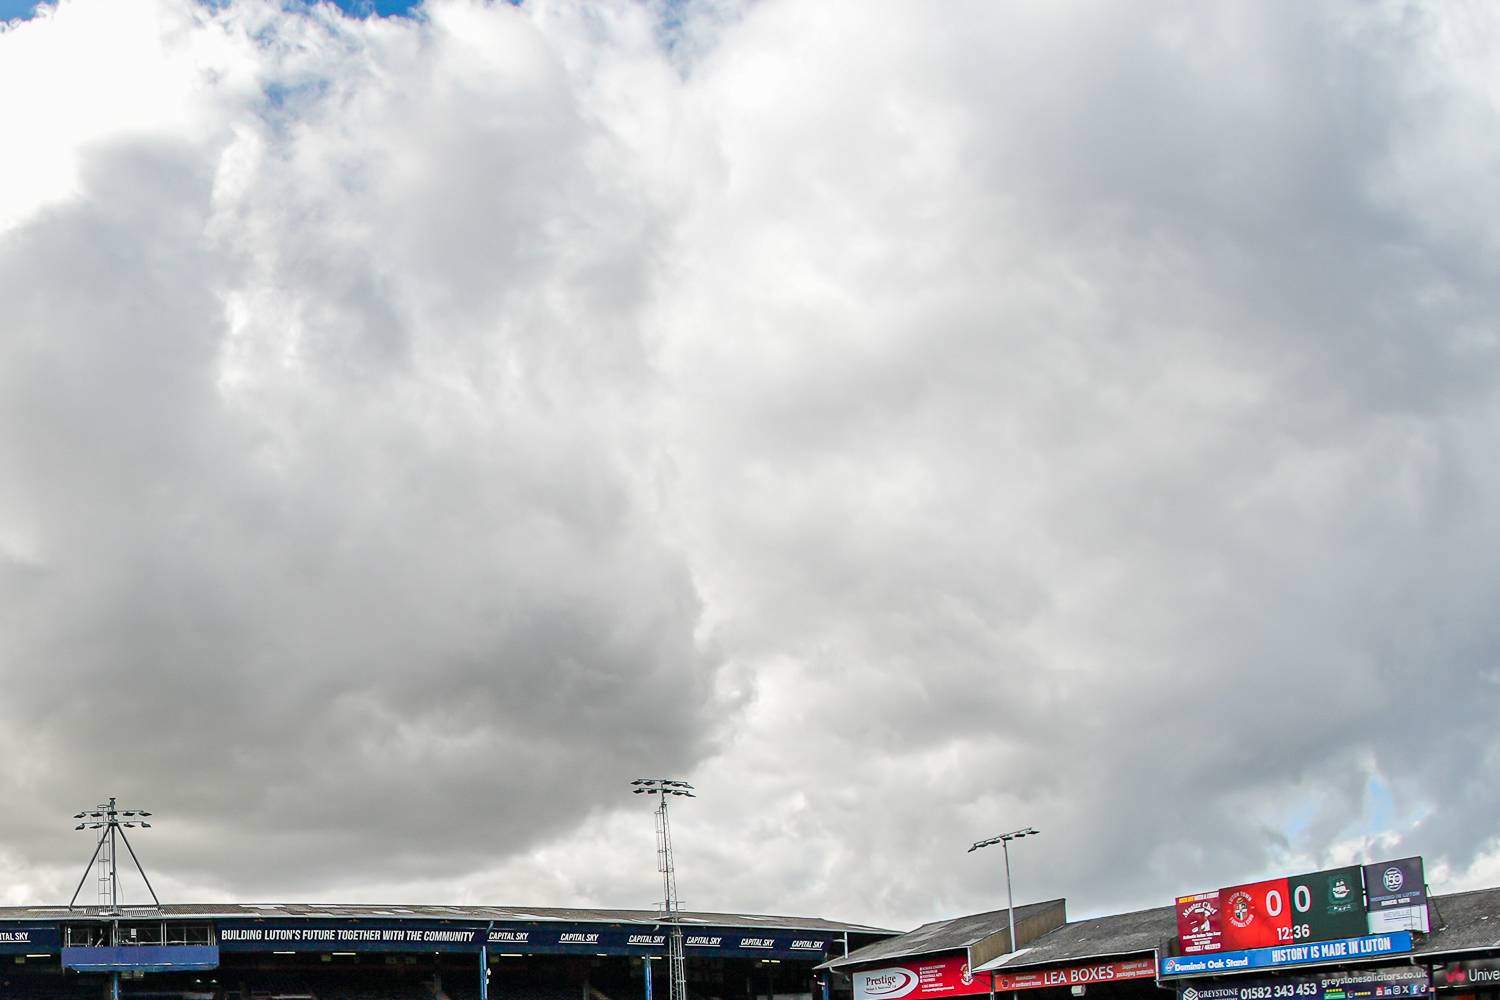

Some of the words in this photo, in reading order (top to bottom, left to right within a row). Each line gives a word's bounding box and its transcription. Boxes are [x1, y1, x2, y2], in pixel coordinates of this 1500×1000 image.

[1228, 891, 1240, 905] LUTON
[1240, 891, 1252, 902] TOWN
[1266, 890, 1282, 917] 0
[1294, 885, 1311, 913] 0
[1384, 909, 1410, 918] NEVILLE
[1229, 917, 1247, 928] FOOTBALL
[15, 932, 29, 941] SKY
[221, 929, 262, 941] BUILDING
[264, 930, 301, 940] LUTON'S
[302, 930, 334, 940] FUTURE
[337, 930, 381, 941] TOGETHER
[383, 930, 405, 941] WITH
[406, 930, 422, 941] THE
[423, 931, 474, 942] COMMUNITY
[488, 932, 514, 941] CAPITAL
[514, 932, 528, 941] SKY
[559, 933, 584, 942] CAPITAL
[585, 933, 598, 942] SKY
[1277, 924, 1310, 940] 12:36
[628, 935, 652, 944] CAPITAL
[652, 935, 665, 944] SKY
[686, 936, 709, 945] CAPITAL
[709, 937, 721, 945] SKY
[739, 938, 762, 946] CAPITAL
[762, 939, 775, 947] SKY
[791, 940, 813, 948] CAPITAL
[1272, 947, 1309, 963] HISTORY
[1311, 946, 1320, 958] IS
[1321, 942, 1347, 958] MADE
[1349, 940, 1359, 954] IN
[1361, 937, 1391, 953] LUTON
[1122, 963, 1137, 971] Supplier
[1174, 960, 1206, 972] Domino's
[1207, 958, 1225, 970] Oak
[1226, 956, 1249, 968] Stand
[866, 974, 897, 987] Prestige
[1044, 971, 1068, 985] LEA
[1070, 965, 1115, 982] BOXES
[1321, 970, 1428, 988] greystonesolicitors.co.uk
[1468, 969, 1500, 982] Unive
[1198, 988, 1238, 999] GREYSTONE
[1241, 986, 1272, 999] 01582
[1274, 985, 1295, 997] 343
[1296, 983, 1318, 995] 453
